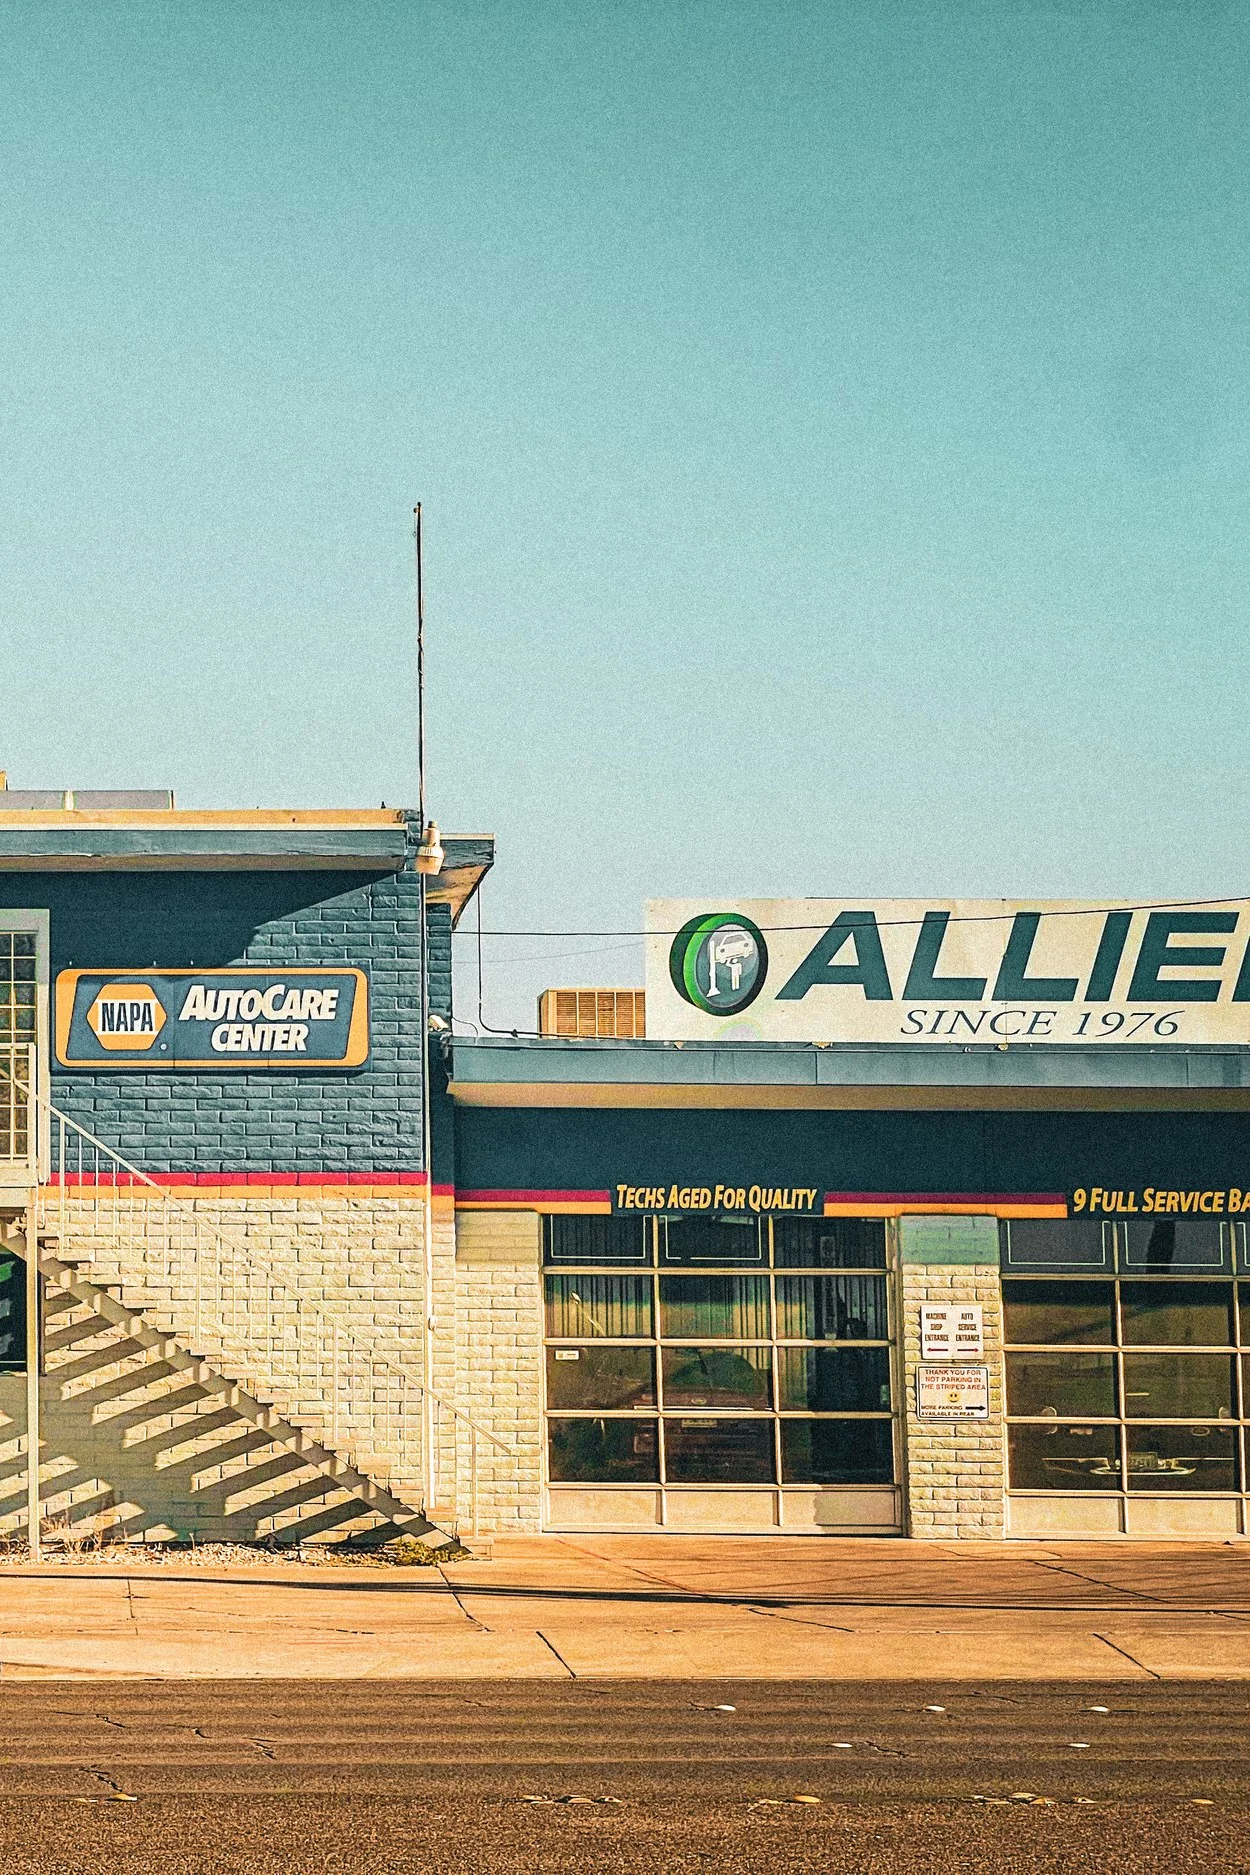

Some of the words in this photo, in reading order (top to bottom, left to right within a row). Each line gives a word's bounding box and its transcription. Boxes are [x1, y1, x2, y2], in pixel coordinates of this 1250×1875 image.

[774, 911, 1250, 1002] ALLIE
[101, 1002, 154, 1032] NAPA
[900, 1009, 1057, 1036] SINCE
[1072, 1010, 1186, 1037] 1976
[211, 1023, 309, 1051] CENTER
[1073, 1188, 1087, 1213] 9
[958, 1323, 977, 1331] SERVICE
[961, 1312, 974, 1320] AUTO
[925, 1334, 949, 1342] ENTRANCE
[956, 1334, 980, 1342] ENTRANCE
